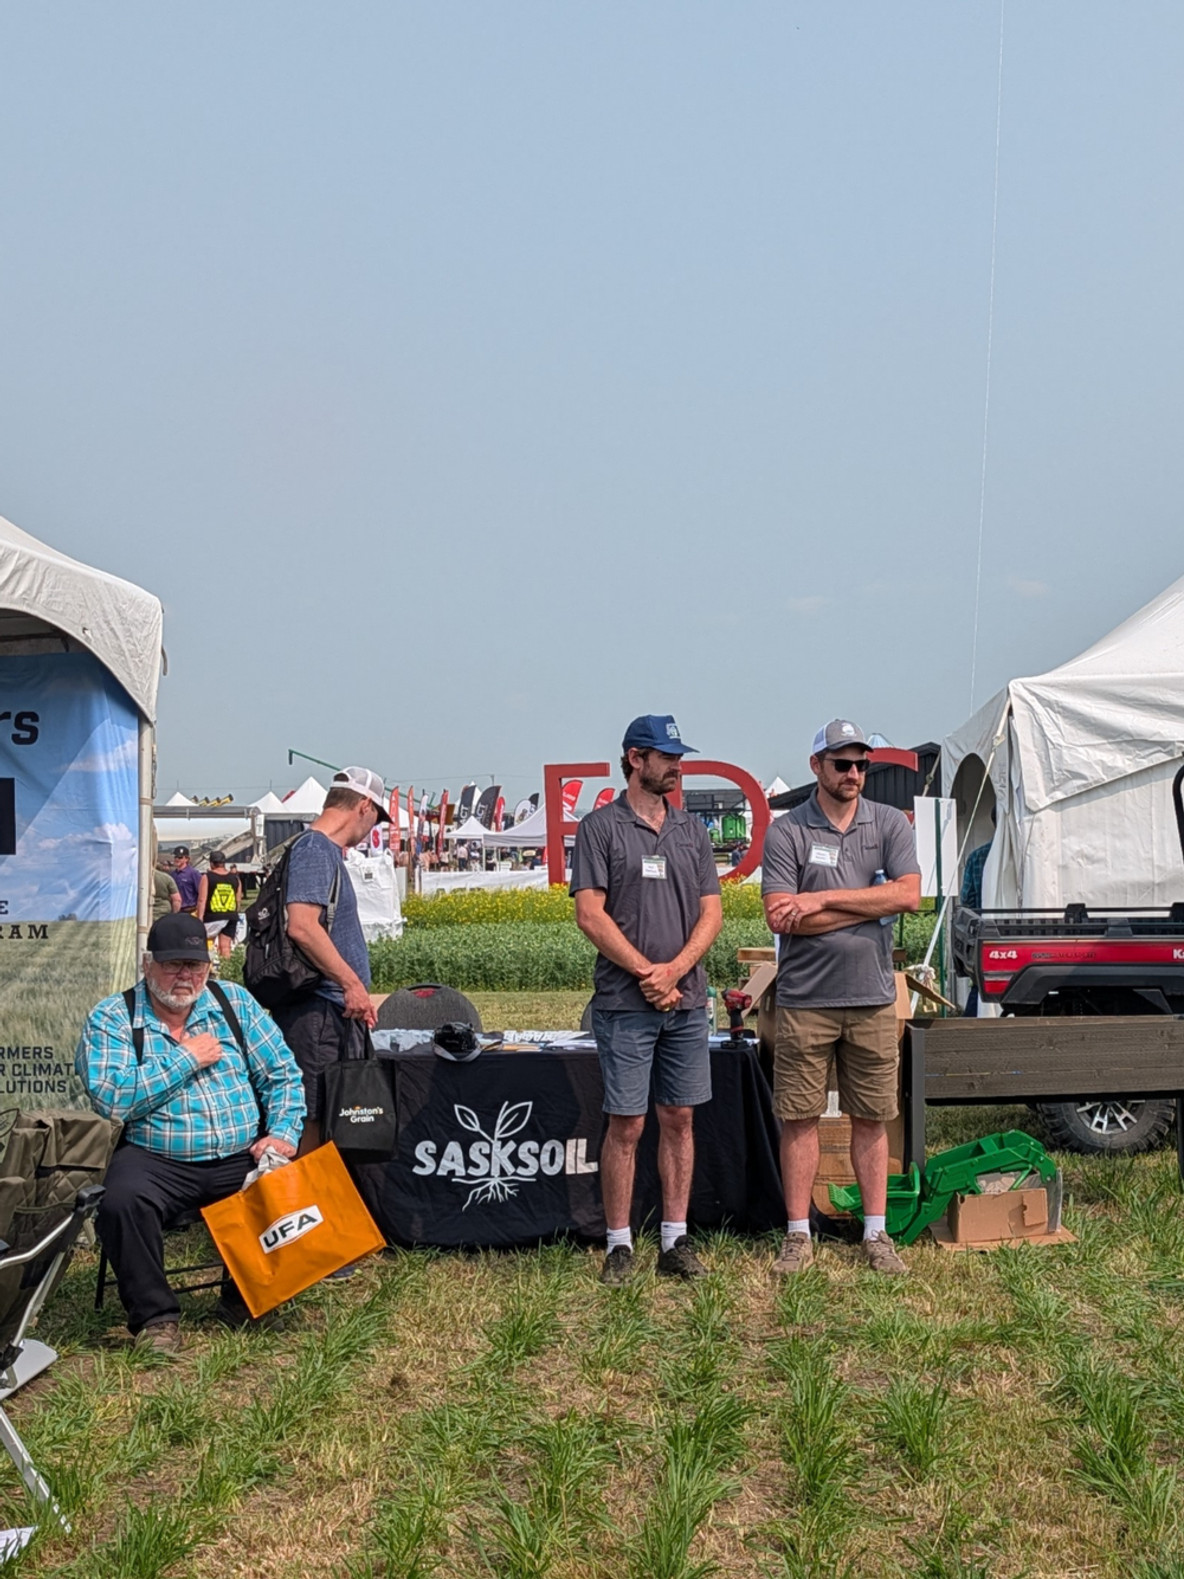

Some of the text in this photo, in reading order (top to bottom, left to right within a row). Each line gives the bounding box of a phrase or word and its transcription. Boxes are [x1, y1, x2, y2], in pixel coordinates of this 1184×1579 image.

[989, 950, 1018, 960] 4x4
[12, 1063, 79, 1076] CLIMAT
[339, 1106, 384, 1117] Johnston's
[350, 1115, 375, 1123] Grain
[412, 1138, 599, 1177] SASKSOIL
[263, 1212, 318, 1249] UFA
